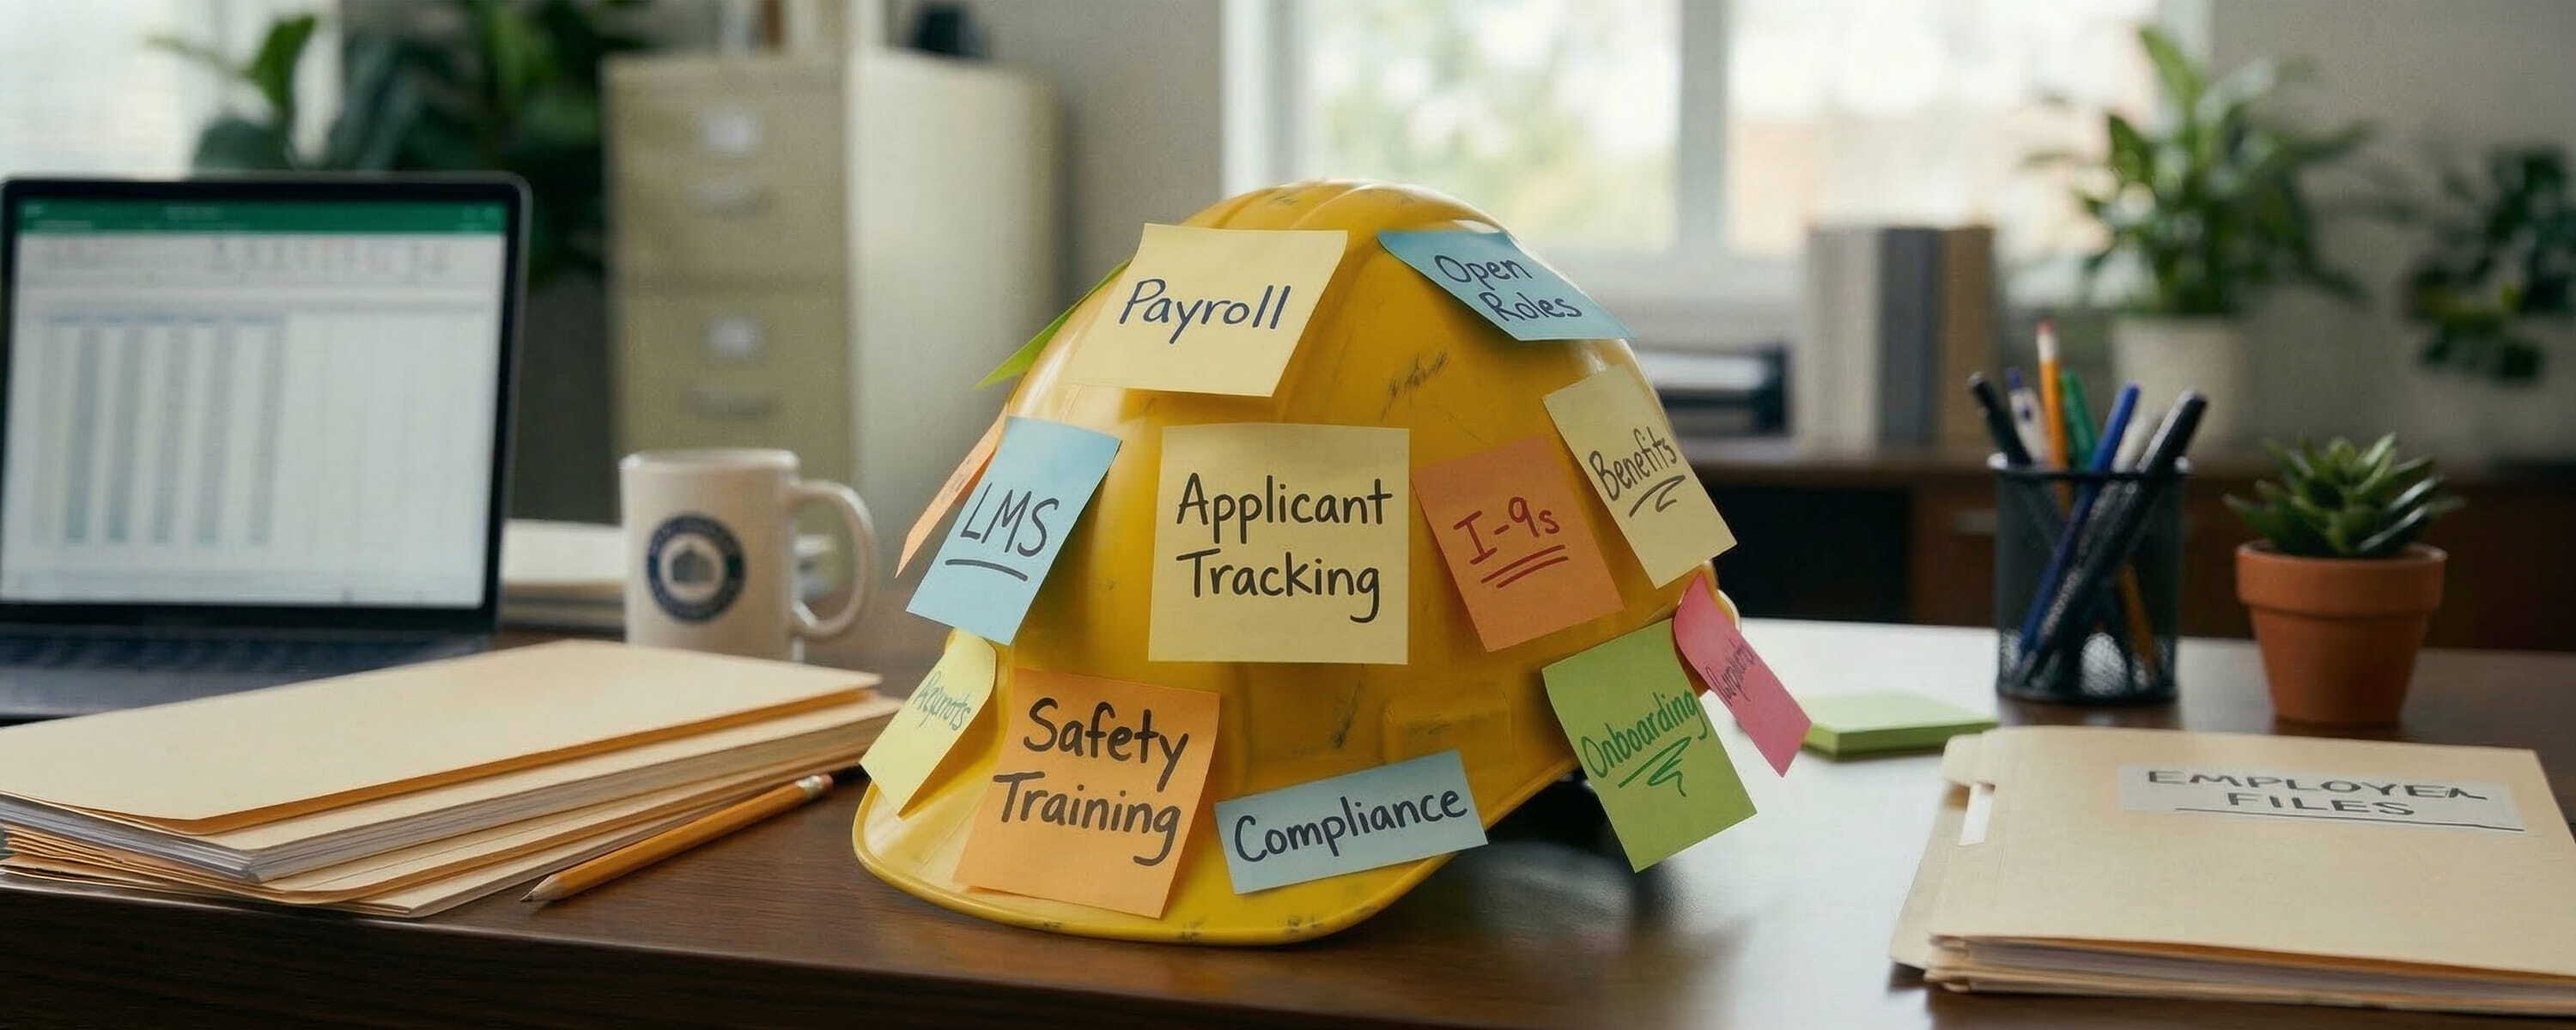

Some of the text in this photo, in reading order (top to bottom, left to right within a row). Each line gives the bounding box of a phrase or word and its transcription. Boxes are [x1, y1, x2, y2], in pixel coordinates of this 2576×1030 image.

[1434, 255, 1533, 291] Open
[1478, 291, 1583, 322] Roles
[1119, 279, 1291, 344] Payroll
[1589, 426, 1677, 501] Benefits
[960, 482, 1060, 557] LMS
[1176, 472, 1394, 544] Applicant
[1453, 496, 1560, 565] I-9s
[1176, 548, 1381, 623] Tracking
[1023, 697, 1189, 793] Safety
[1581, 689, 1708, 779] Onboarding
[993, 771, 1182, 867] Training
[1234, 790, 1468, 863] Compliance
[2227, 791, 2415, 816] FILES
